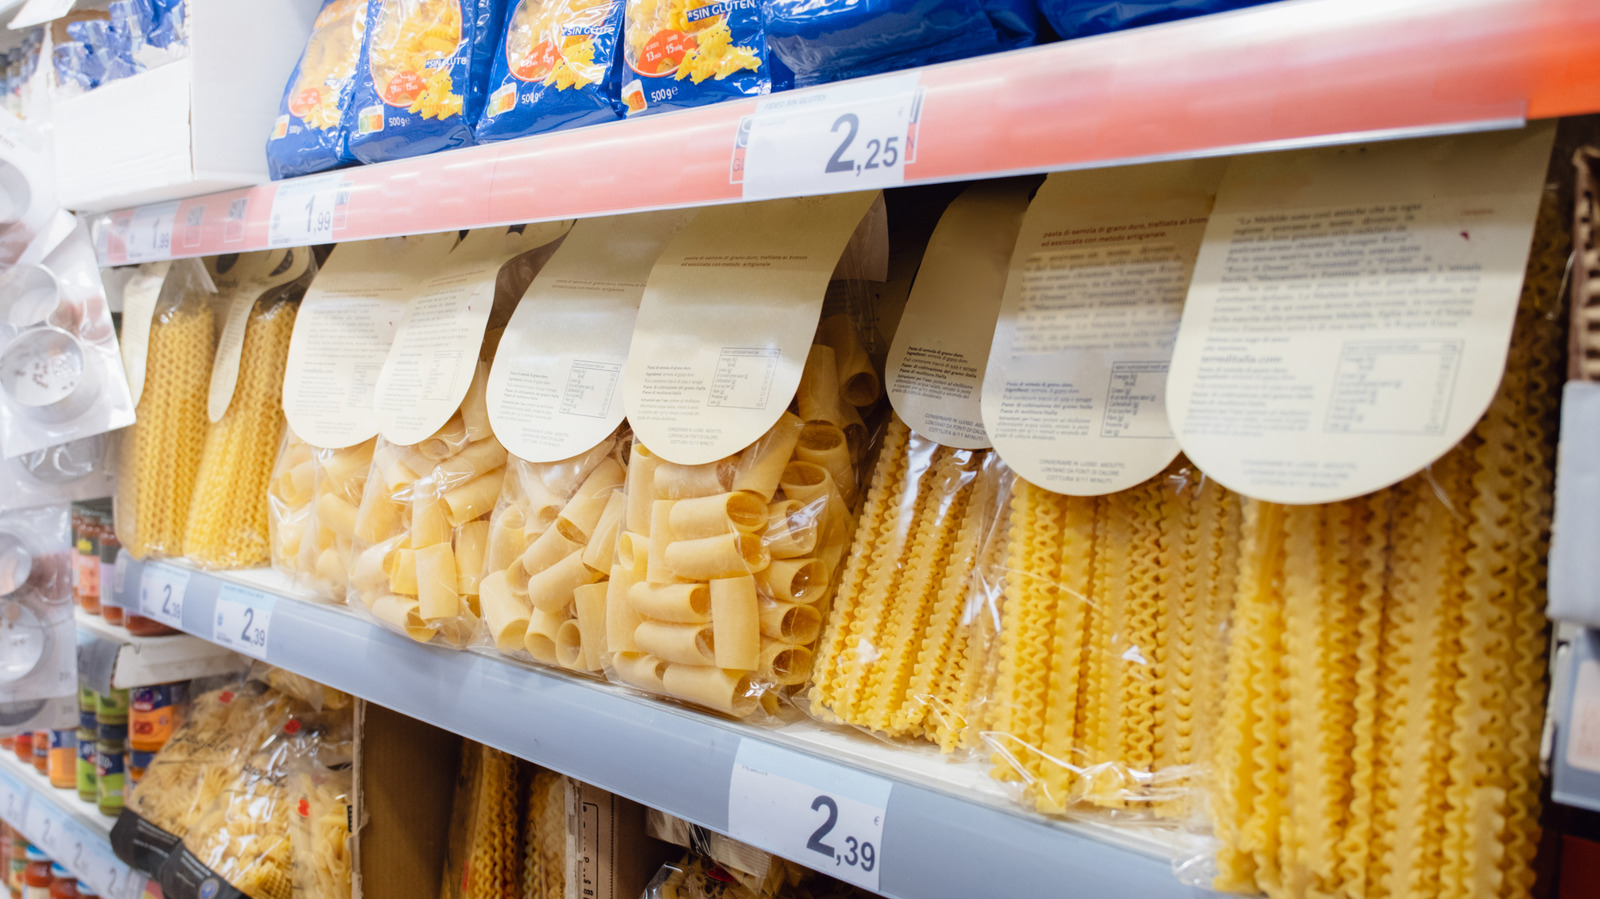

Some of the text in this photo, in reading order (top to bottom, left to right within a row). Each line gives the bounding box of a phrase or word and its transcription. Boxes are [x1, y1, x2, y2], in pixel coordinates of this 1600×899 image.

[712, 0, 757, 14] GLUTEN
[825, 112, 899, 177] 2,25
[305, 194, 330, 236] 1,99
[241, 607, 265, 647] 2,39
[807, 795, 875, 872] 2,39
